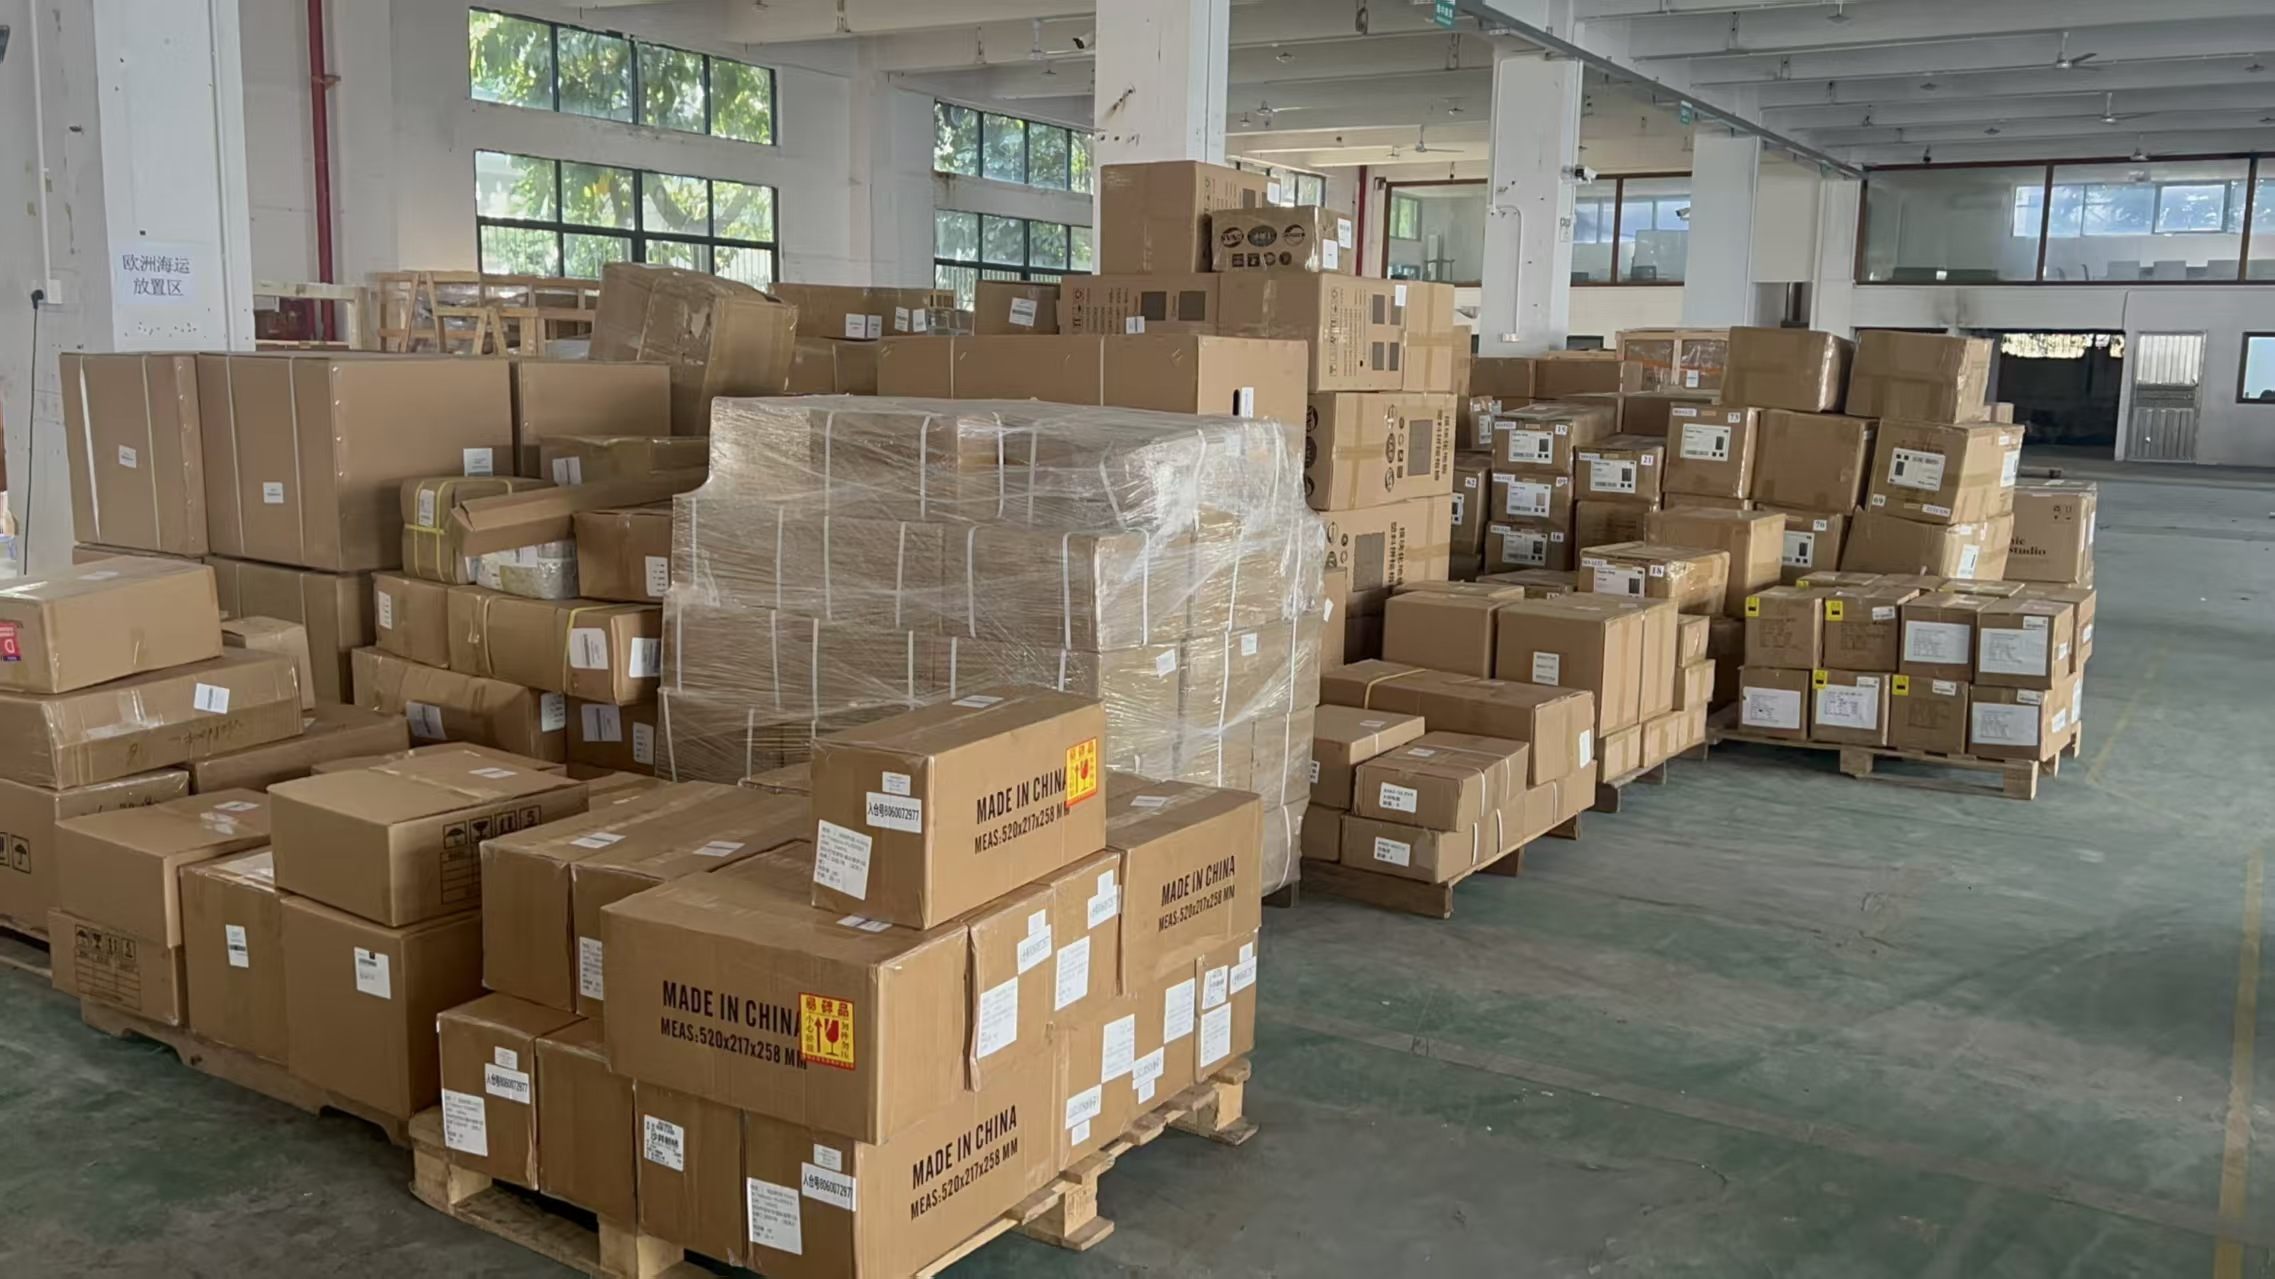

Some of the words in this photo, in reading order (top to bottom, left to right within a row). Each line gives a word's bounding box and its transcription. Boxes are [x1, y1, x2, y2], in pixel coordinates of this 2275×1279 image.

[122, 253, 191, 274] 欧洲海运
[133, 277, 184, 296] 放置区
[977, 786, 1012, 825] MADE
[1016, 780, 1029, 809] IN
[975, 805, 1055, 855] MEAS:520x217x258
[1161, 873, 1190, 907] MADE
[1192, 868, 1203, 893] IN
[1205, 855, 1235, 887] CHINA
[663, 980, 713, 1017] MADE
[720, 993, 739, 1024] IN
[661, 1017, 781, 1064] MEAS:520x217x258
[912, 1142, 953, 1190] MADE
[957, 1130, 971, 1163] IN
[975, 1104, 1017, 1150] CHINA
[910, 1147, 1001, 1220] MEAS:520x217x258
[1002, 1137, 1018, 1161] MM
